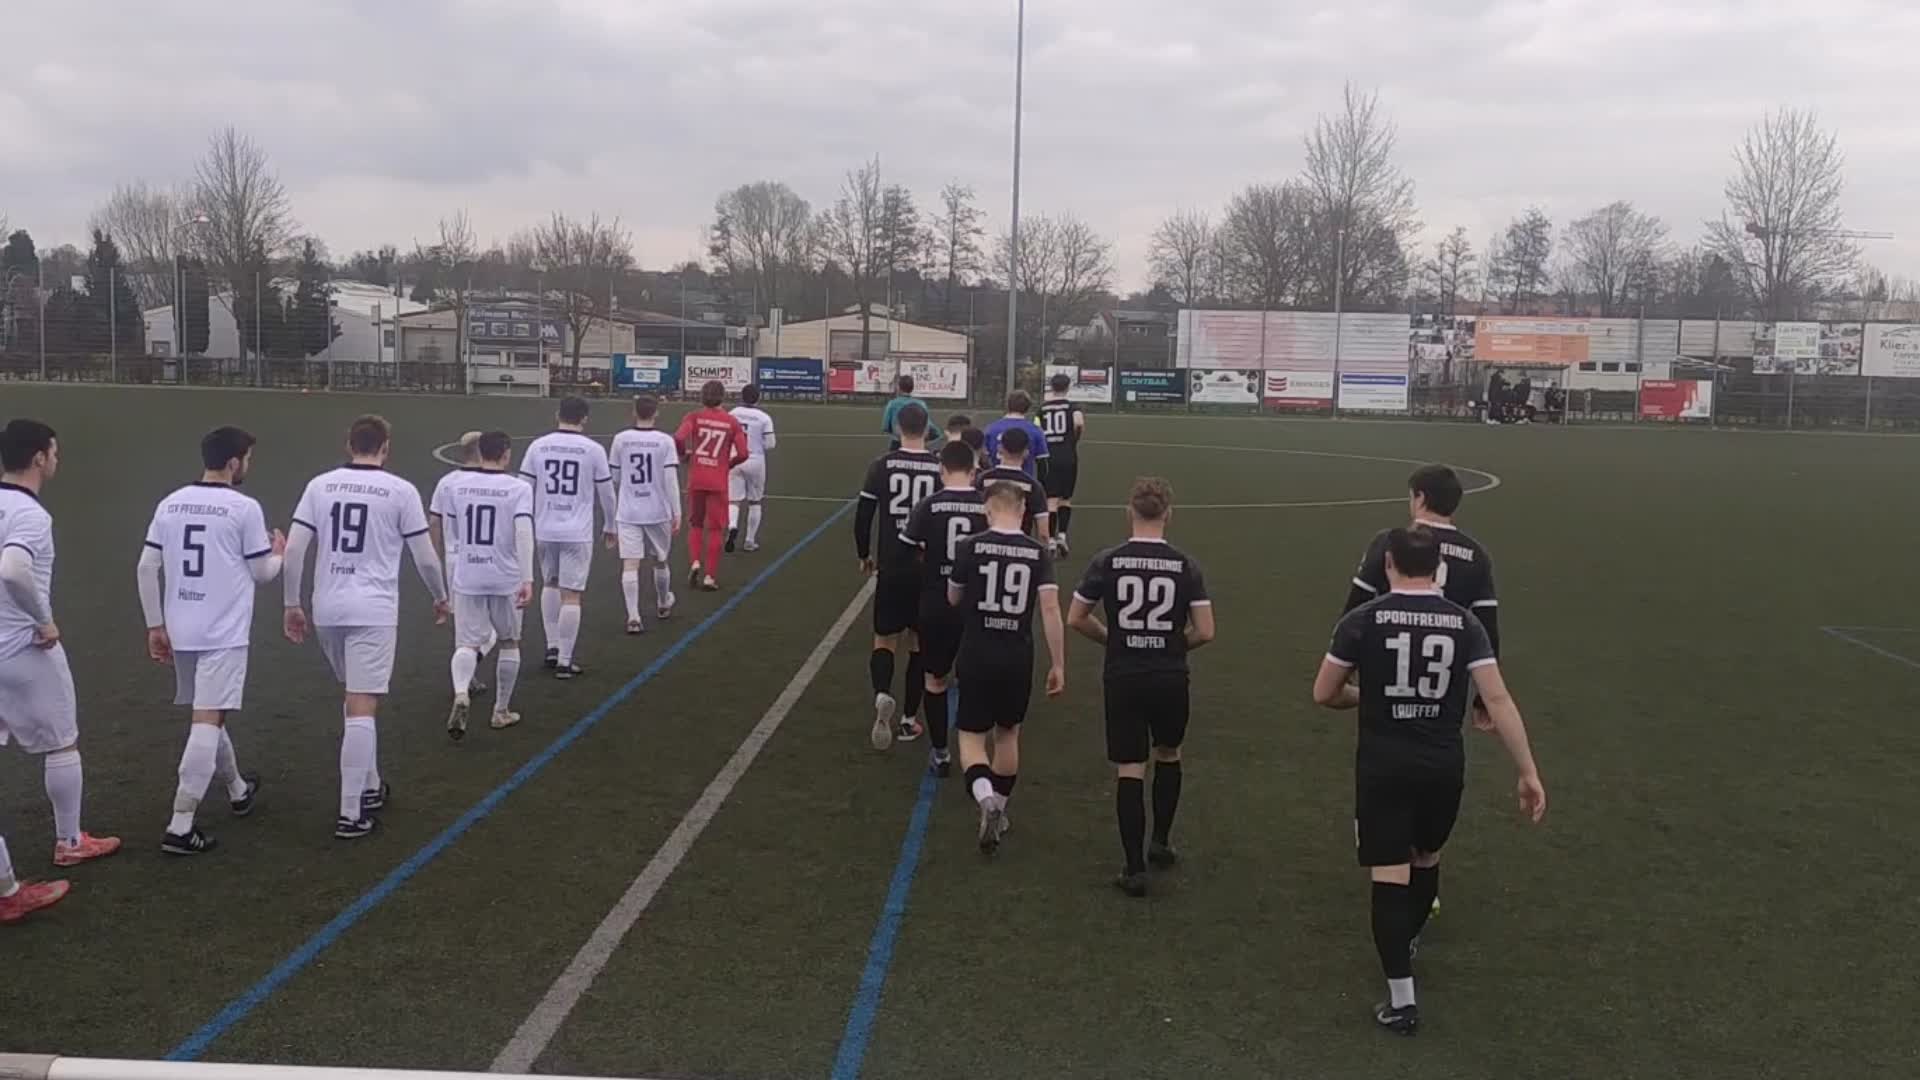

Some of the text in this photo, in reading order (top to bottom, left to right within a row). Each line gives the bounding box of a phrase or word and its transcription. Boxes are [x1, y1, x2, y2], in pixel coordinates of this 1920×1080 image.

[687, 366, 733, 379] SCHMIDT
[1043, 410, 1067, 435] 10
[696, 427, 726, 458] 27
[544, 459, 580, 496] 39
[630, 453, 652, 484] 31
[325, 483, 391, 499] TSV PFEDELBACH
[329, 501, 369, 554] 19
[465, 503, 497, 546] 10
[183, 523, 207, 577] 5
[974, 542, 1040, 561] SPORTFREUNDE
[1111, 556, 1184, 574] SPORTFREUNDE
[977, 560, 1032, 615] 19
[1117, 575, 1176, 631] 22
[1375, 610, 1465, 631] SPORTFREUNDE
[1126, 634, 1166, 649] LAUFFEN
[1384, 632, 1456, 700] 13
[1392, 703, 1441, 720] LAUFFEN
